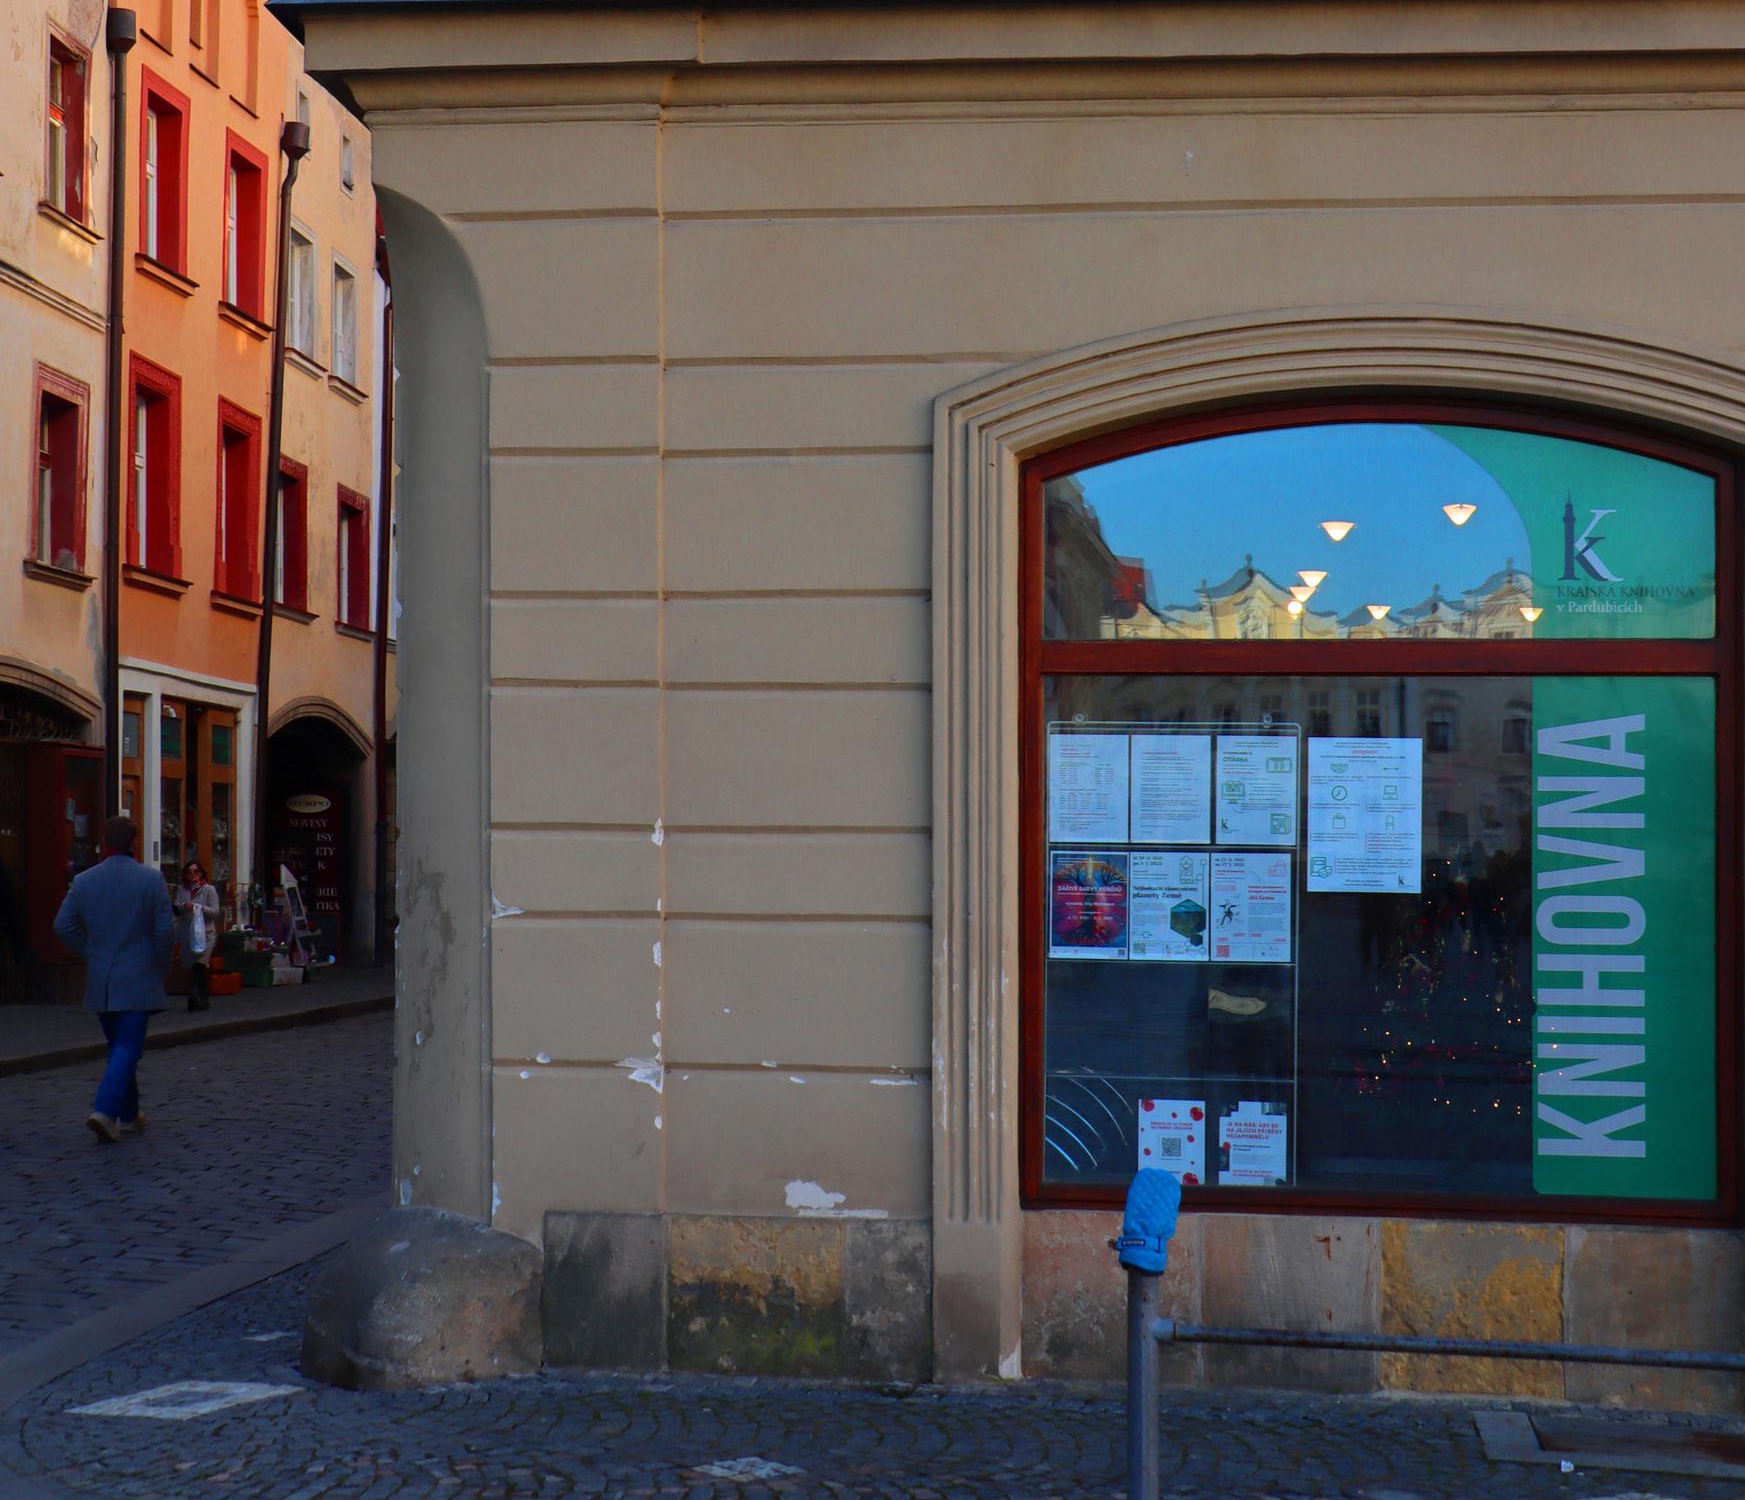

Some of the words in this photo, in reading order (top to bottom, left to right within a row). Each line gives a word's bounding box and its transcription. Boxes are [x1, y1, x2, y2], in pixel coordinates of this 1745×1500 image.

[1557, 584, 1616, 598] KRAJSKÁ
[1620, 585, 1696, 598] KNIHOVNA
[1556, 604, 1565, 613] v
[1568, 601, 1642, 613] Pardubicích
[288, 819, 328, 828] NOVINY
[1536, 713, 1646, 1158] KNIHOVNA
